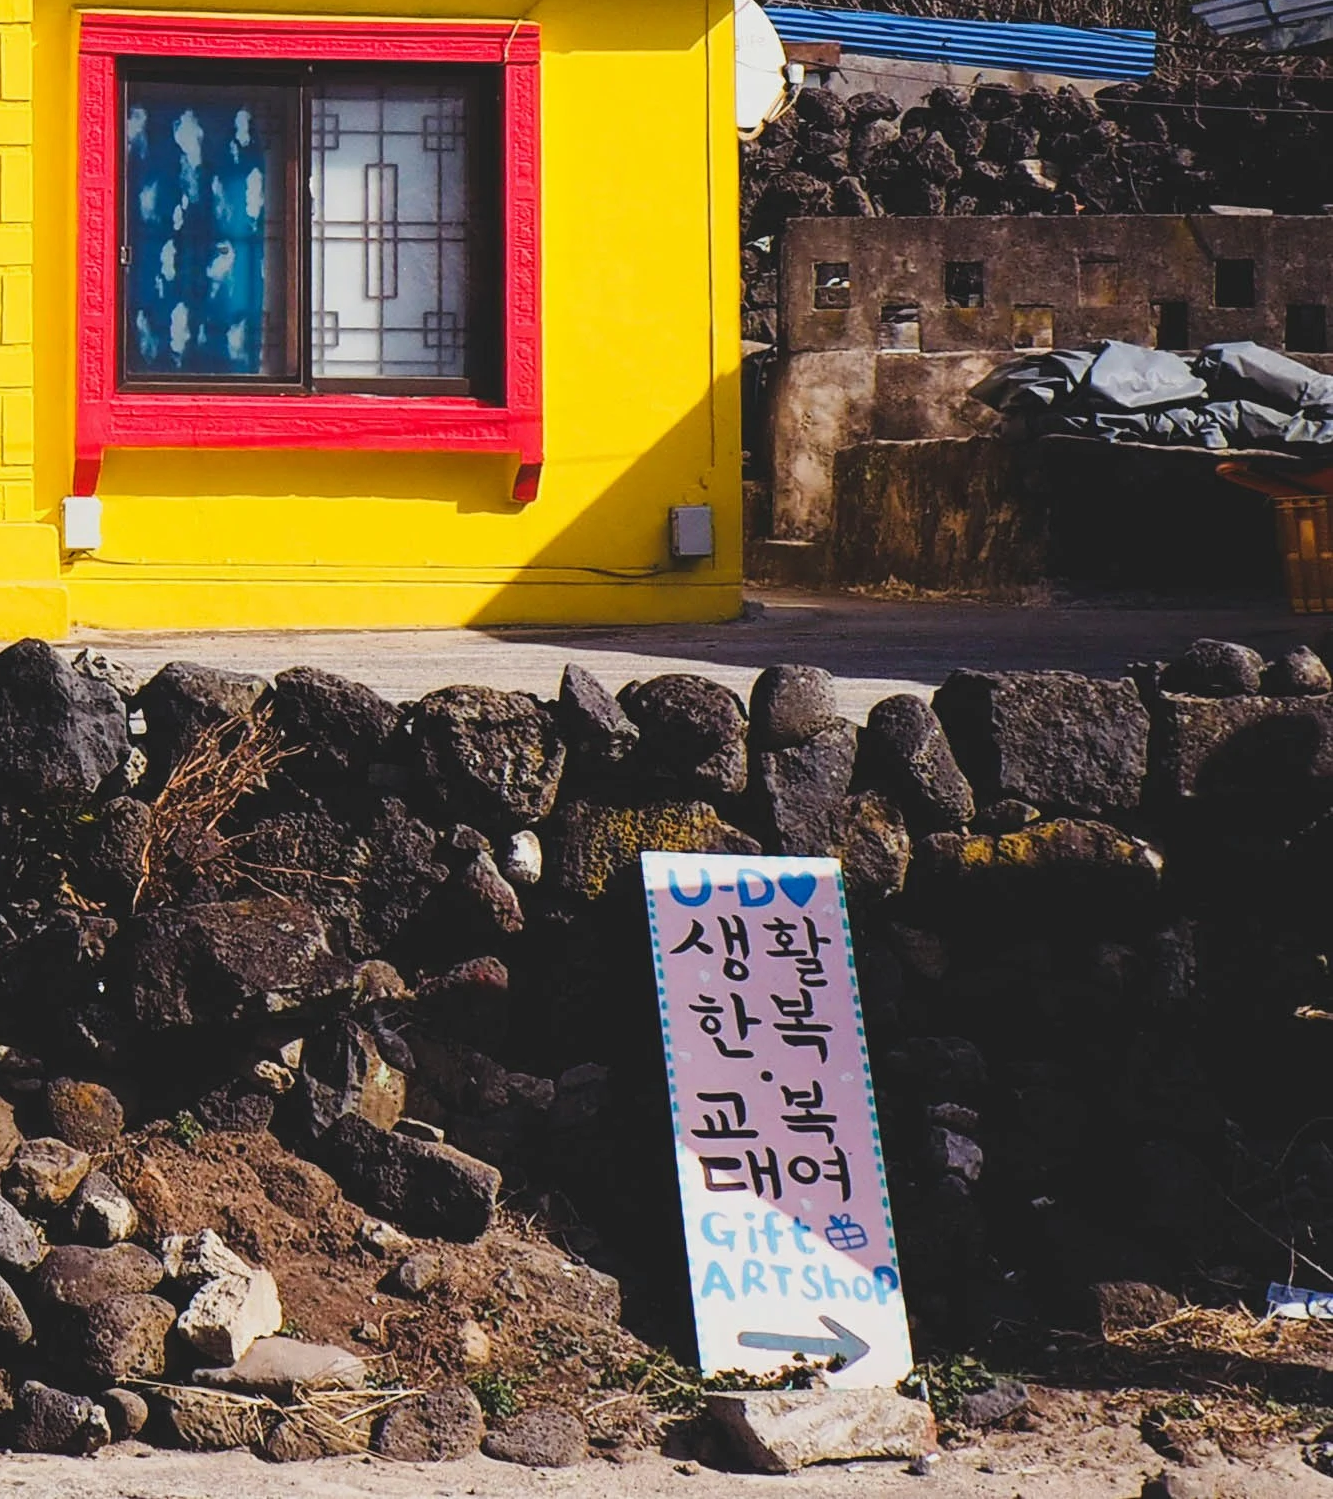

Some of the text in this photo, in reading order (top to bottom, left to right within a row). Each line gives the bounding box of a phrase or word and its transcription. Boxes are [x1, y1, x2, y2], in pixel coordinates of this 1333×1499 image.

[669, 914, 832, 987] 생활
[688, 988, 833, 1063] 한복
[690, 1080, 837, 1145] 교복
[699, 1145, 852, 1203] 대여
[699, 1209, 817, 1256] Gift
